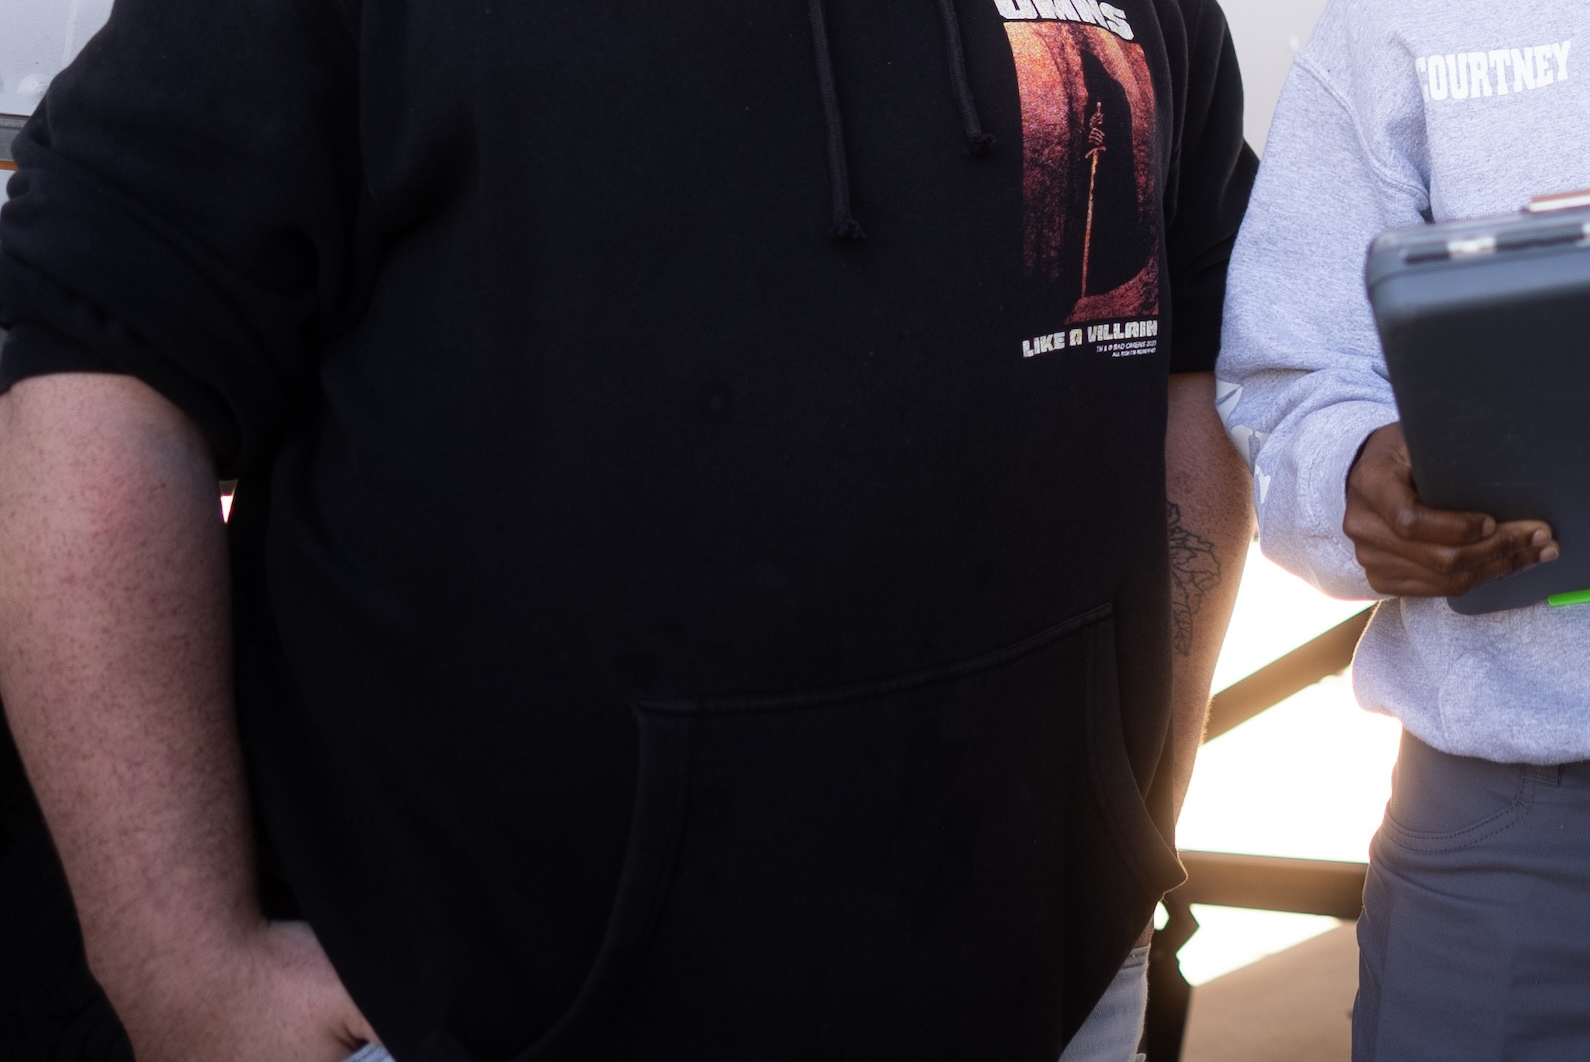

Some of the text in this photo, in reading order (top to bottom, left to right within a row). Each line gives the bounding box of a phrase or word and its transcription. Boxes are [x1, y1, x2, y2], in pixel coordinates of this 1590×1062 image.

[1022, 320, 1158, 358] LIKE A VILLAIN
